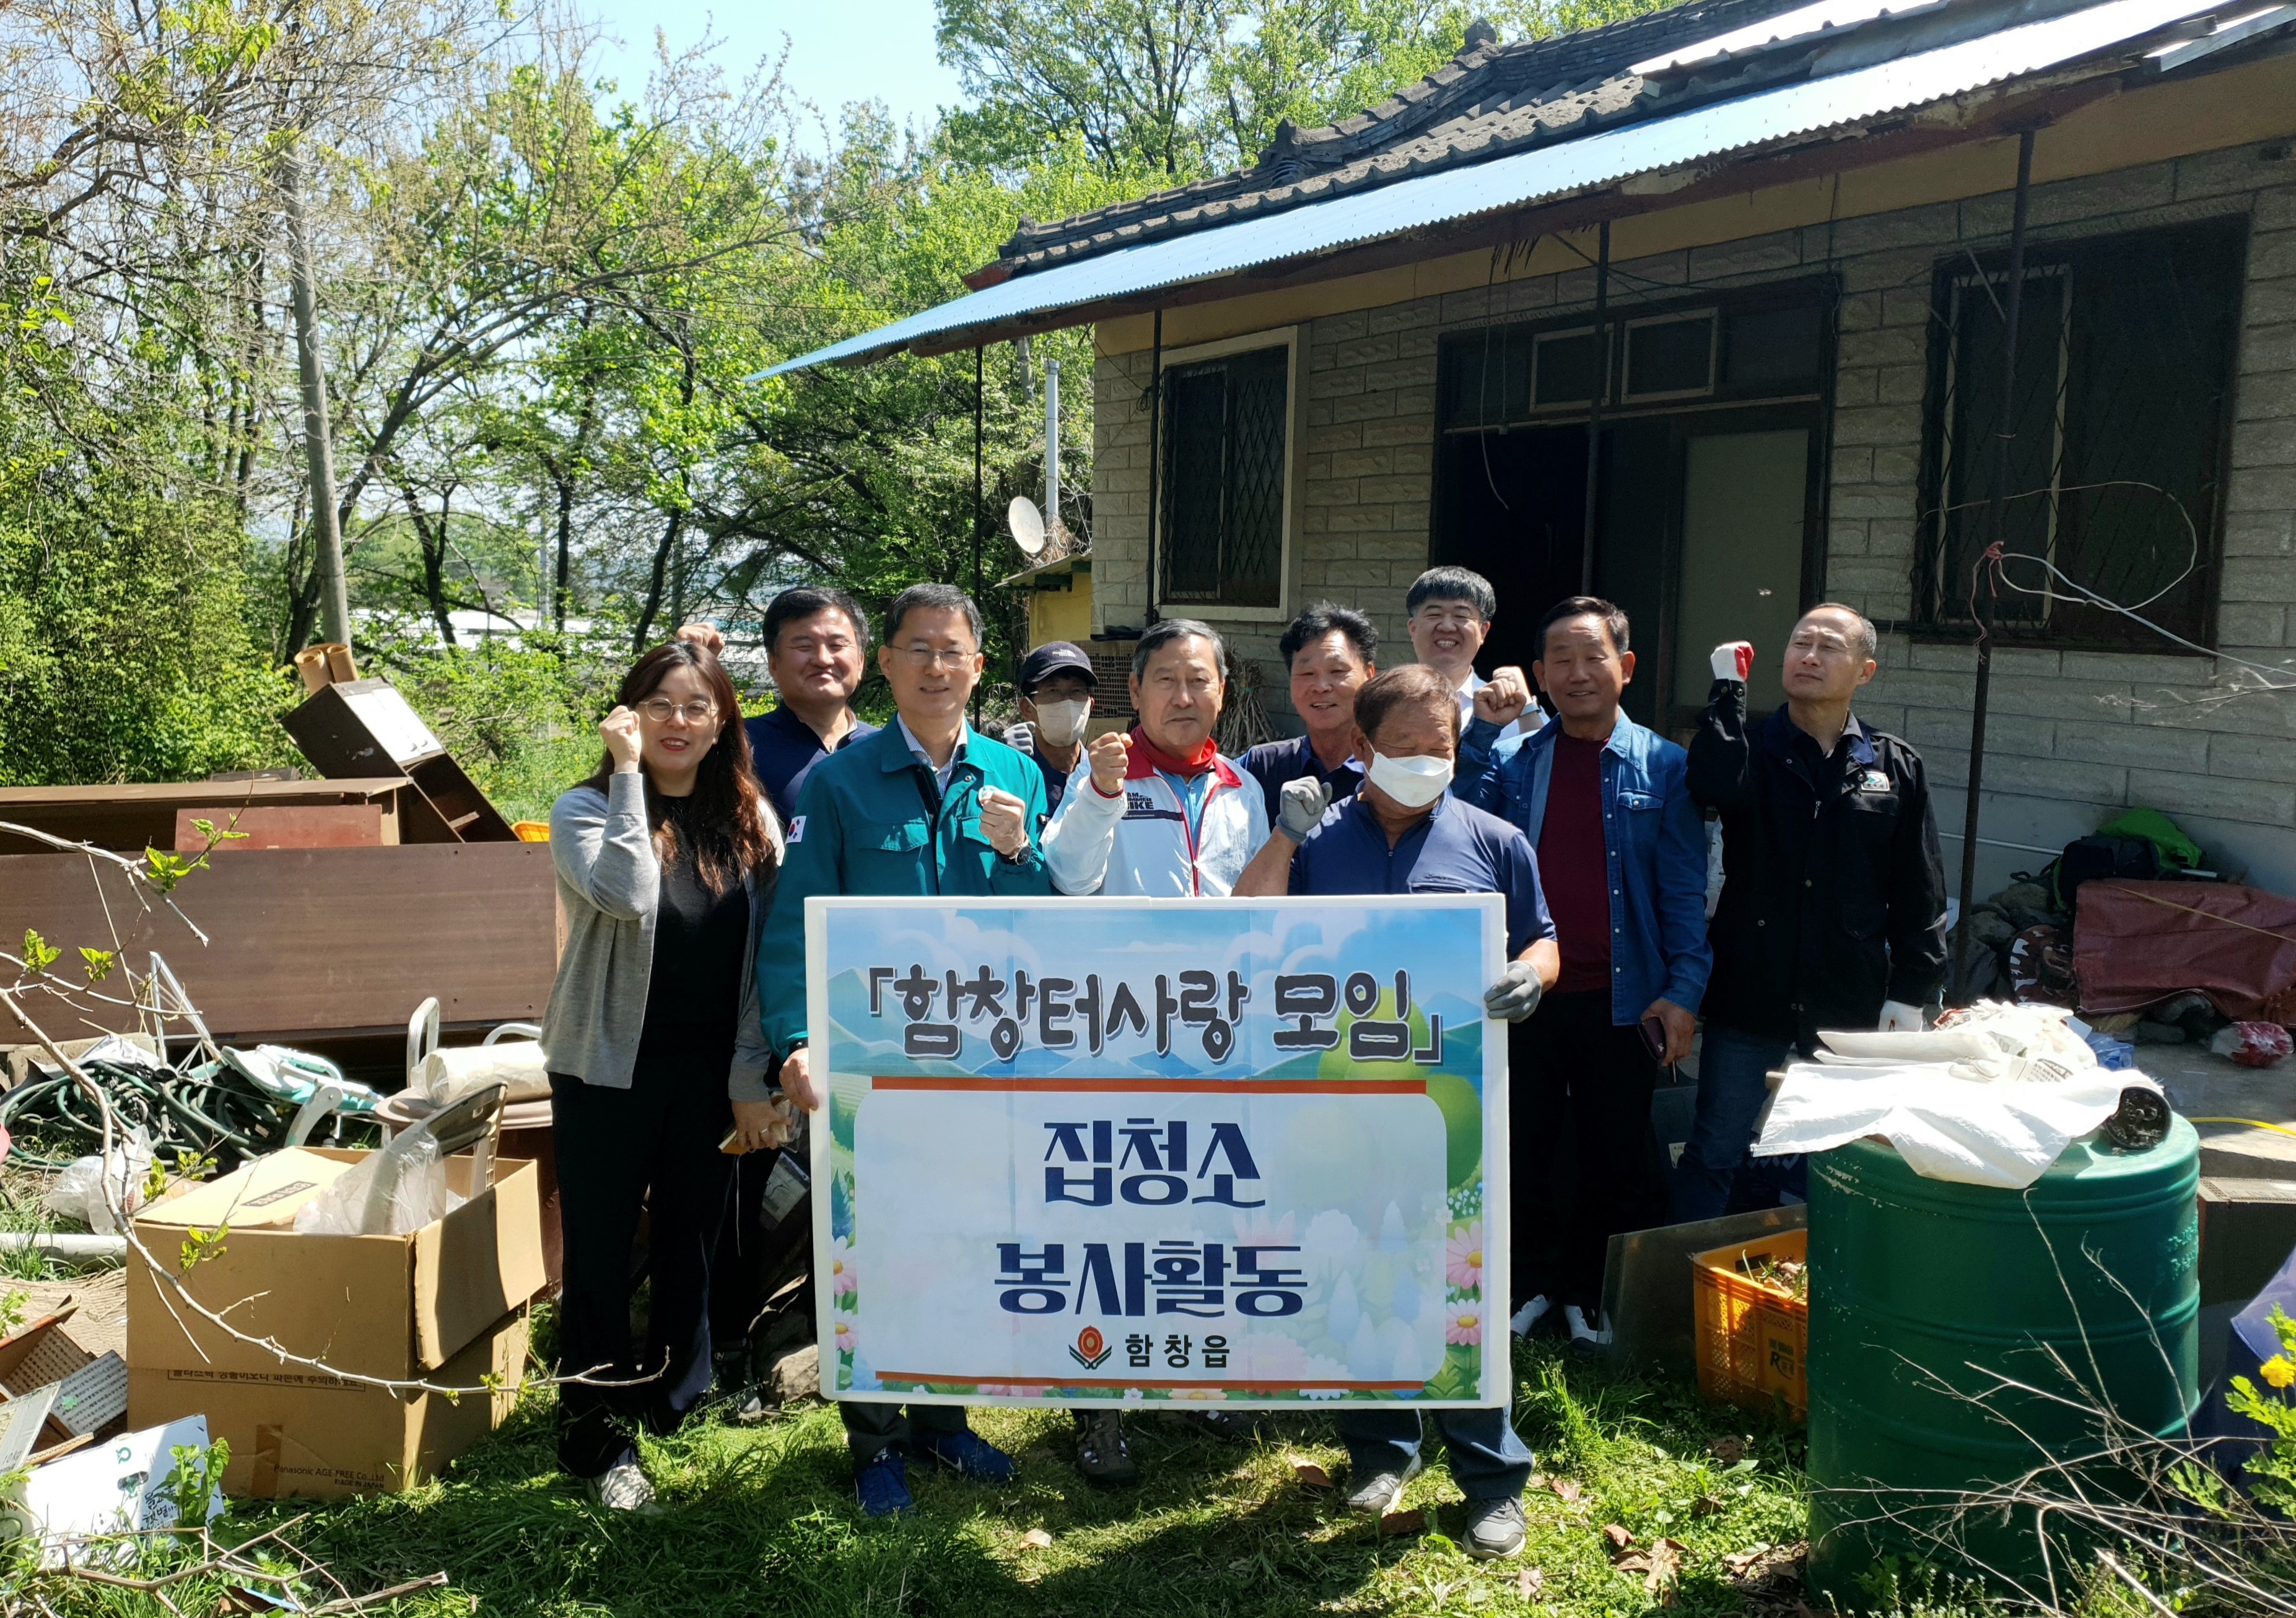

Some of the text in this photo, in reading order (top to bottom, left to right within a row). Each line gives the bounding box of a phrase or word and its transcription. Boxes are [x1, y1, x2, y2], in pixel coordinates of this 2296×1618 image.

[1127, 801, 1155, 810] IKE
[1043, 1117, 1266, 1209] 집청소
[993, 1240, 1309, 1318] 봉사활동
